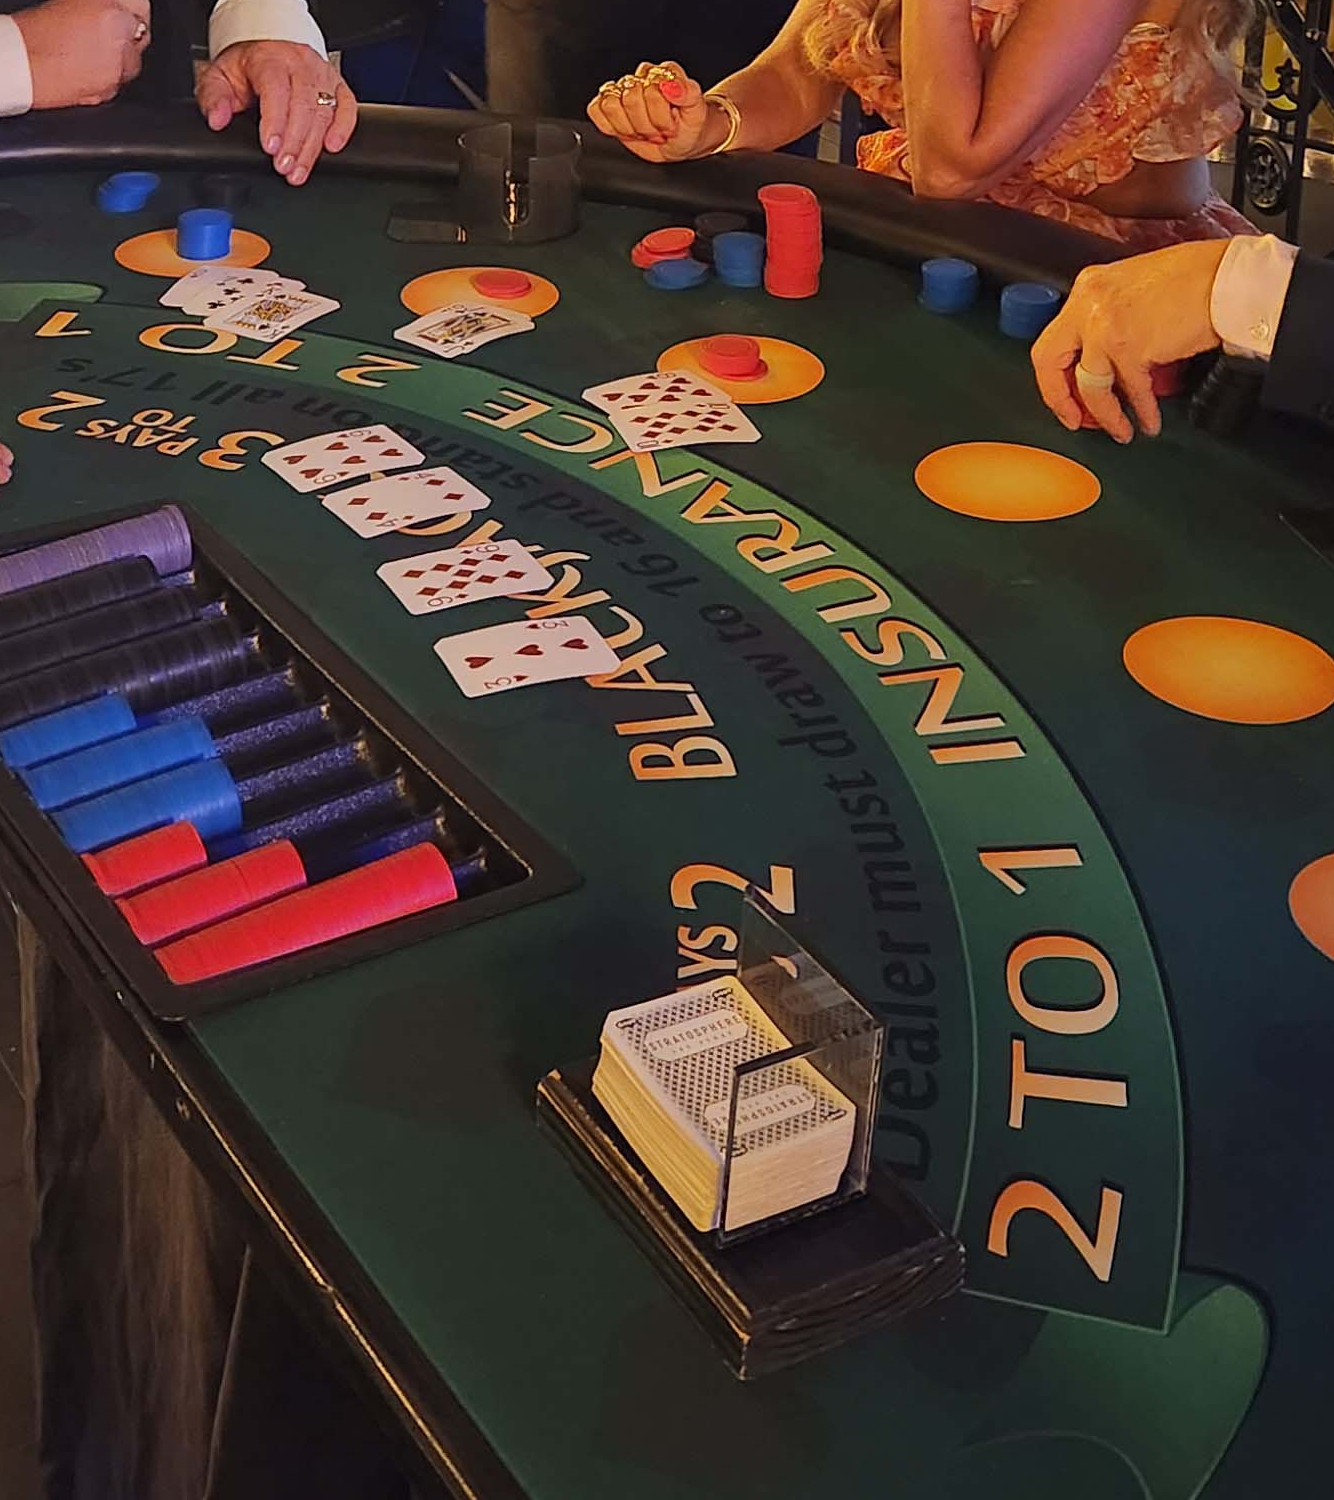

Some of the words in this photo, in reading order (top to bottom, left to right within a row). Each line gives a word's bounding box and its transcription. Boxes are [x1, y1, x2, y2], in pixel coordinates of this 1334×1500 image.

[34, 311, 92, 337] 1
[138, 322, 306, 372] TO
[191, 378, 286, 405] all
[335, 354, 424, 388] 2
[16, 390, 108, 432] 2
[132, 408, 198, 434] TO
[75, 418, 201, 457] PAYS
[198, 430, 287, 471] 3
[518, 490, 647, 549] and
[463, 389, 1027, 766] INSURANCE
[622, 553, 700, 597] 16
[316, 470, 738, 780] BLACK
[699, 604, 762, 643] to
[742, 652, 858, 760] draw
[823, 769, 922, 914] must
[670, 862, 795, 914] 2
[977, 844, 1084, 895] 1
[676, 925, 742, 993] YS
[648, 1013, 743, 1052] STRATOSPHERE
[870, 929, 942, 1183] Dealer
[1005, 934, 1129, 1130] TO
[714, 1091, 813, 1130] STRATOSPHE
[987, 1179, 1123, 1283] 2
